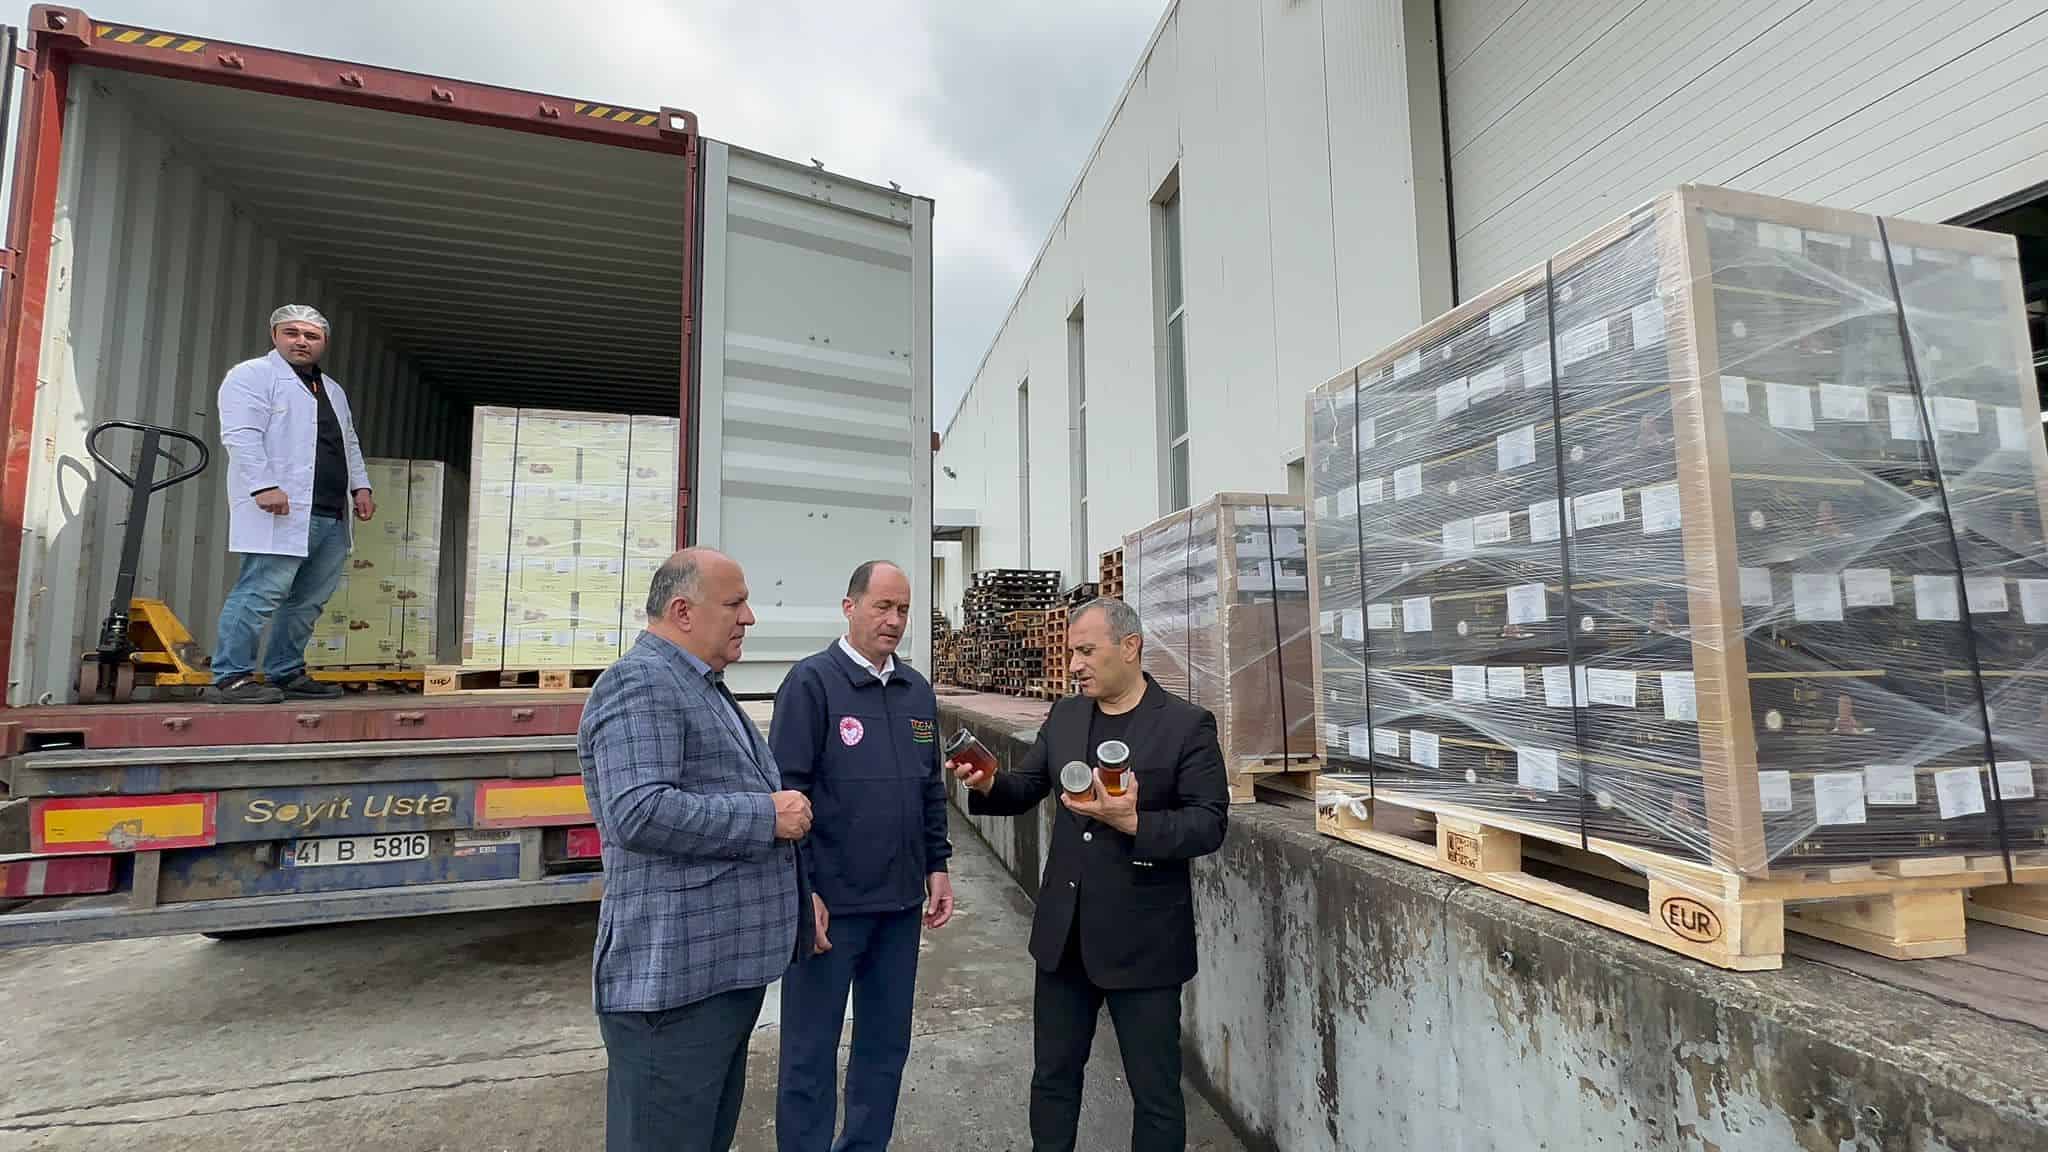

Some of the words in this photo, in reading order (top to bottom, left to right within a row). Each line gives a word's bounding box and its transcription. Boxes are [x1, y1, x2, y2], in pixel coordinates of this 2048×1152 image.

[363, 794, 453, 819] Usta
[297, 841, 320, 864] 41
[337, 841, 355, 861] B
[373, 836, 425, 858] 5816
[1669, 903, 1711, 937] EUR
